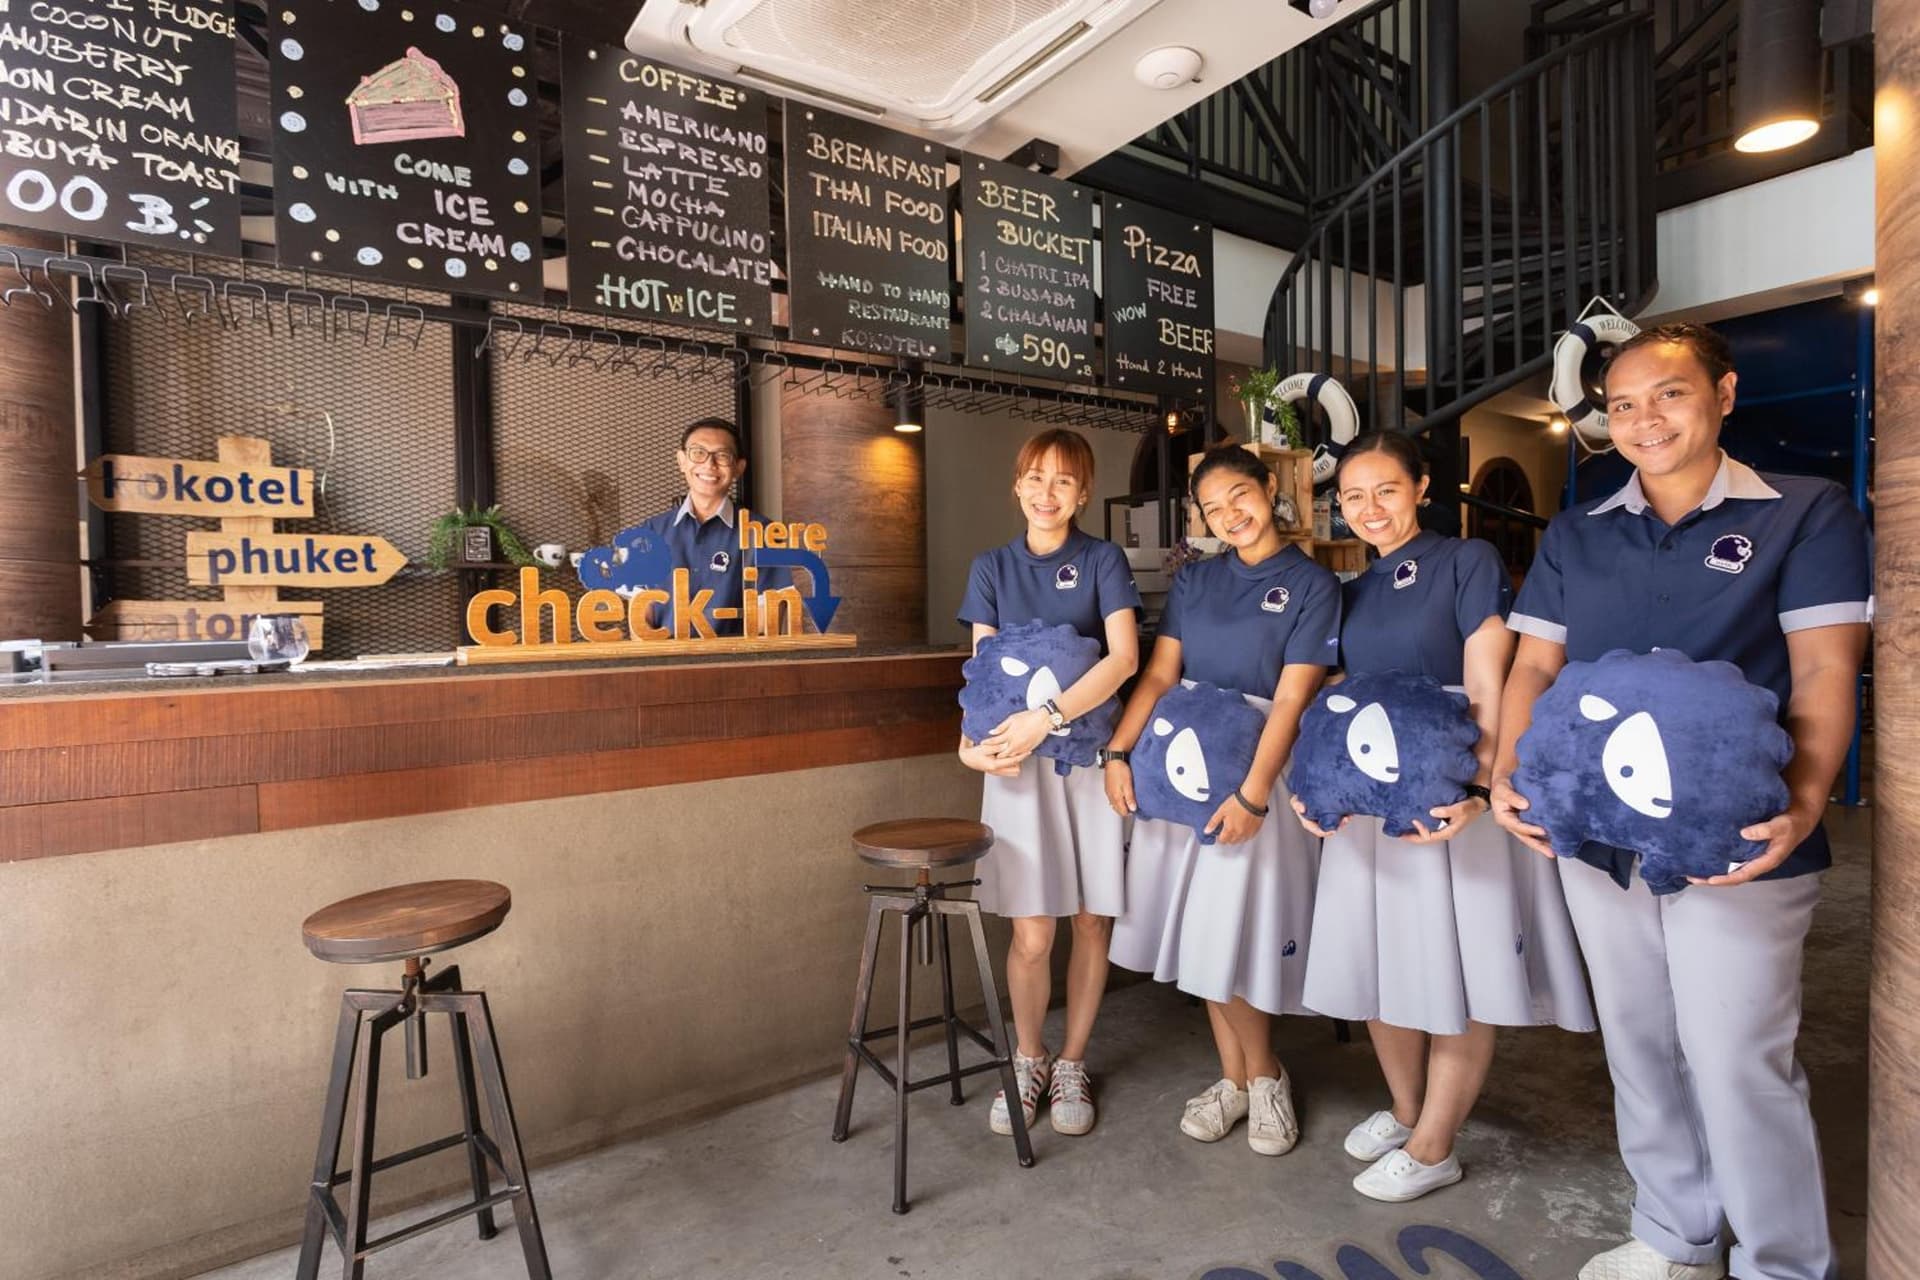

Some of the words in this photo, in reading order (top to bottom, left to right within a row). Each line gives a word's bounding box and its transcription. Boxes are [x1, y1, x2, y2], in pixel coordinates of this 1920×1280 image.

[30, 2, 193, 53] COCONUT
[148, 0, 236, 38] FUDGE
[63, 77, 195, 123] CREAM
[619, 58, 738, 110] COFFEE
[619, 100, 766, 154] AMERICANO
[0, 129, 119, 170] BUYA
[132, 152, 240, 194] TOAST
[394, 153, 472, 187] COME
[618, 126, 762, 179] ESPRESSO
[807, 132, 944, 191] BREAKFAST
[324, 172, 399, 200] WITH
[623, 156, 730, 196] LATTE
[434, 189, 495, 226] ICE
[627, 180, 725, 218] MOCHA
[808, 171, 871, 207] THAI
[885, 190, 944, 225] FOOD
[977, 180, 1060, 223] BEER
[396, 222, 506, 257] CREAM
[621, 205, 765, 254] CAPPUCINO
[813, 210, 892, 252] ITALIAN
[899, 230, 948, 262] FOOD
[997, 219, 1091, 265] BUCKET
[616, 236, 770, 286] CHOCALATE
[980, 250, 987, 271] 1
[995, 256, 1059, 284] CHATRI
[1064, 270, 1090, 290] IPA
[1123, 225, 1202, 279] Pizza
[596, 273, 669, 312] HOT
[686, 287, 738, 323] ICE
[816, 270, 874, 295] HAND
[881, 282, 901, 299] TO
[908, 286, 950, 310] HAND
[978, 275, 991, 293] 2
[996, 279, 1076, 310] BUSSABA
[1146, 277, 1198, 309] FREE
[848, 299, 950, 330] RESTAURANT
[980, 300, 993, 320] 2
[997, 305, 1088, 335] CHALAWAN
[841, 329, 932, 357] KOKOTEL
[1157, 318, 1214, 355] BEER
[1116, 352, 1150, 373] Hand
[1157, 359, 1166, 376] 2
[738, 508, 828, 552] here
[207, 538, 378, 585] phuket
[466, 566, 803, 646] check-in
